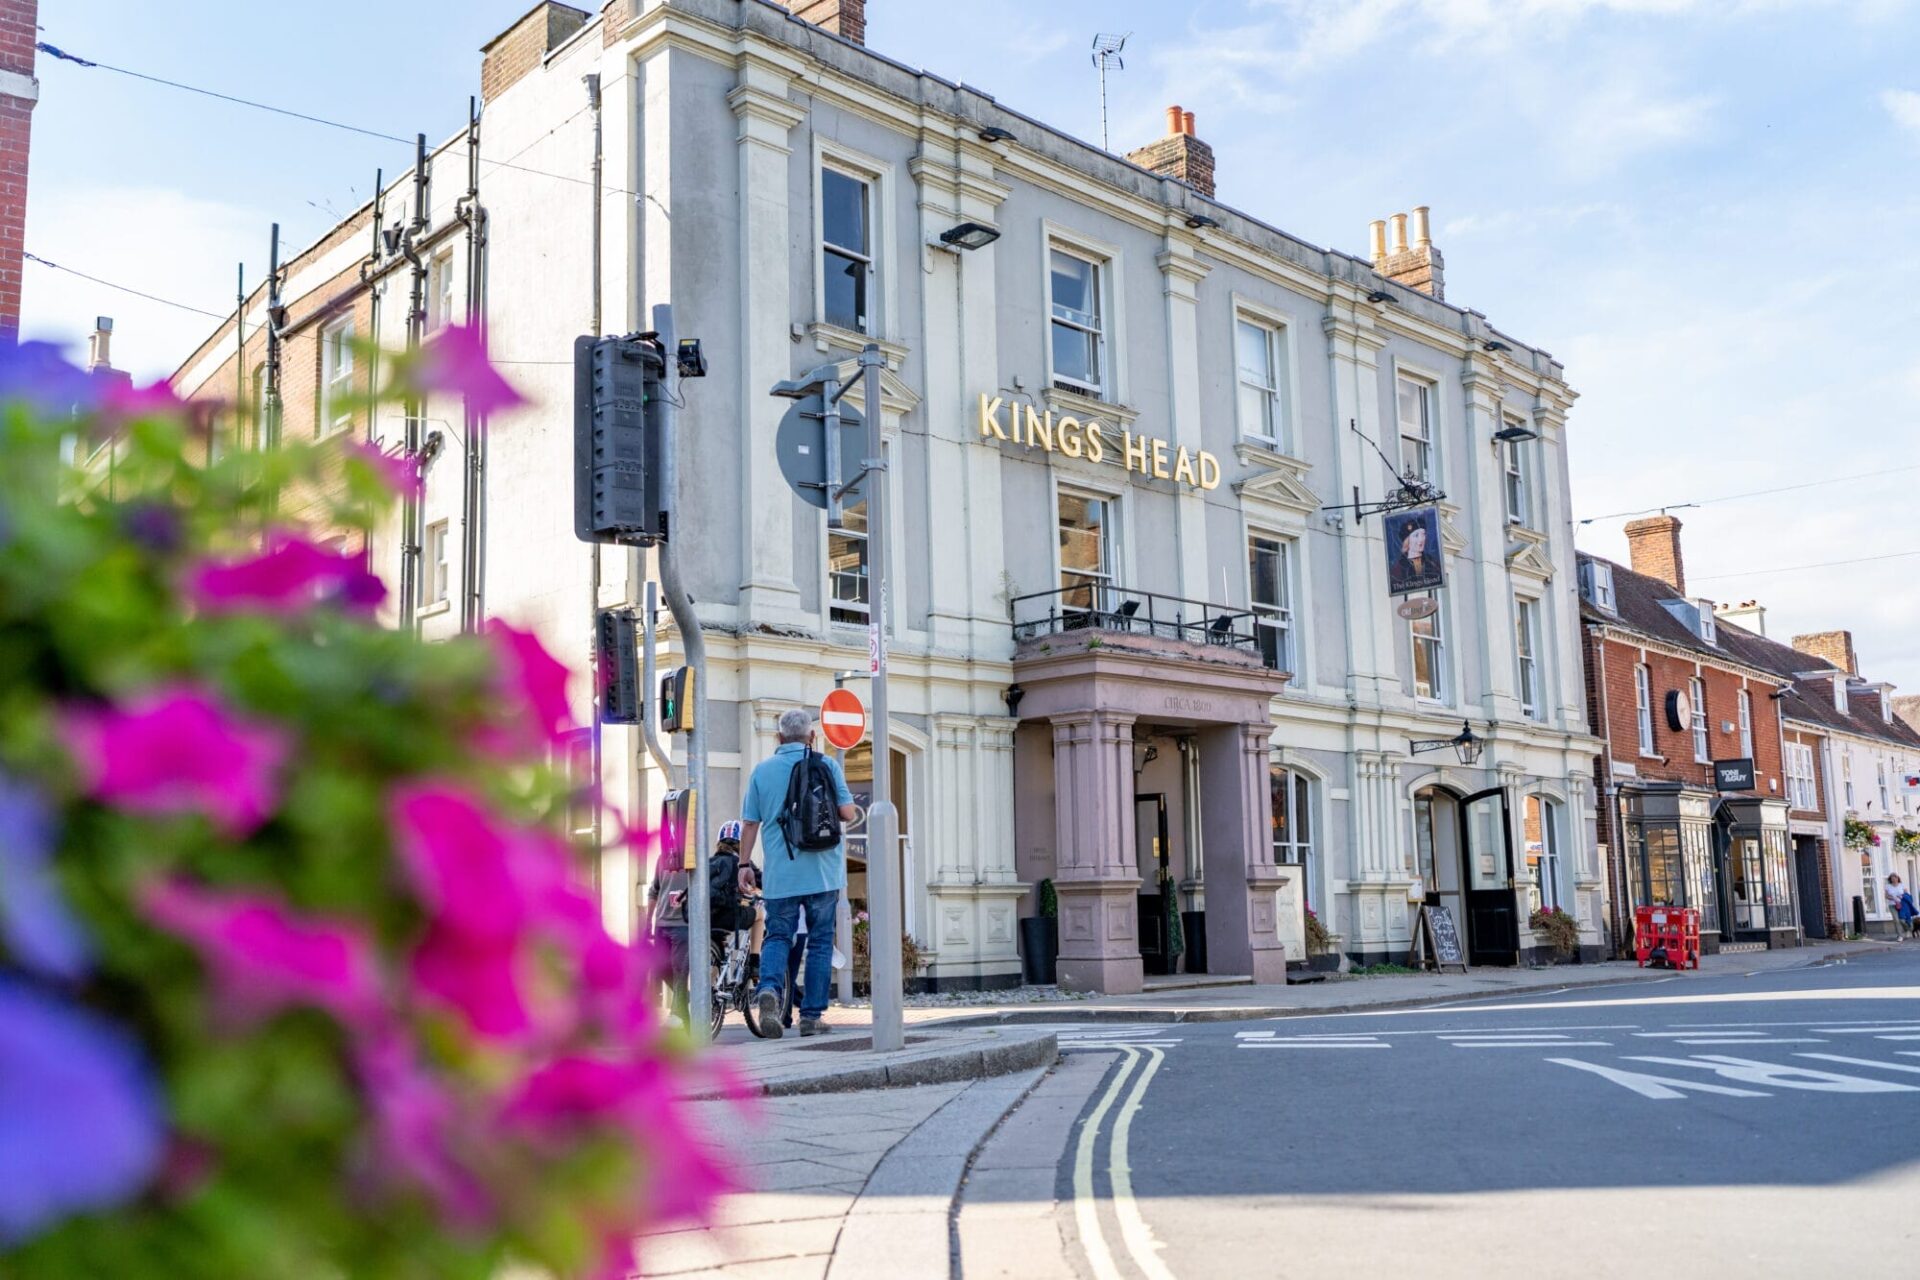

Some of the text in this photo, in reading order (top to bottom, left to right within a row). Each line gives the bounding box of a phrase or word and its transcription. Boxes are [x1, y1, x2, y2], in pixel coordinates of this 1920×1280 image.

[979, 392, 1221, 490] KINGS HEAD
[1720, 769, 1739, 777] TONI
